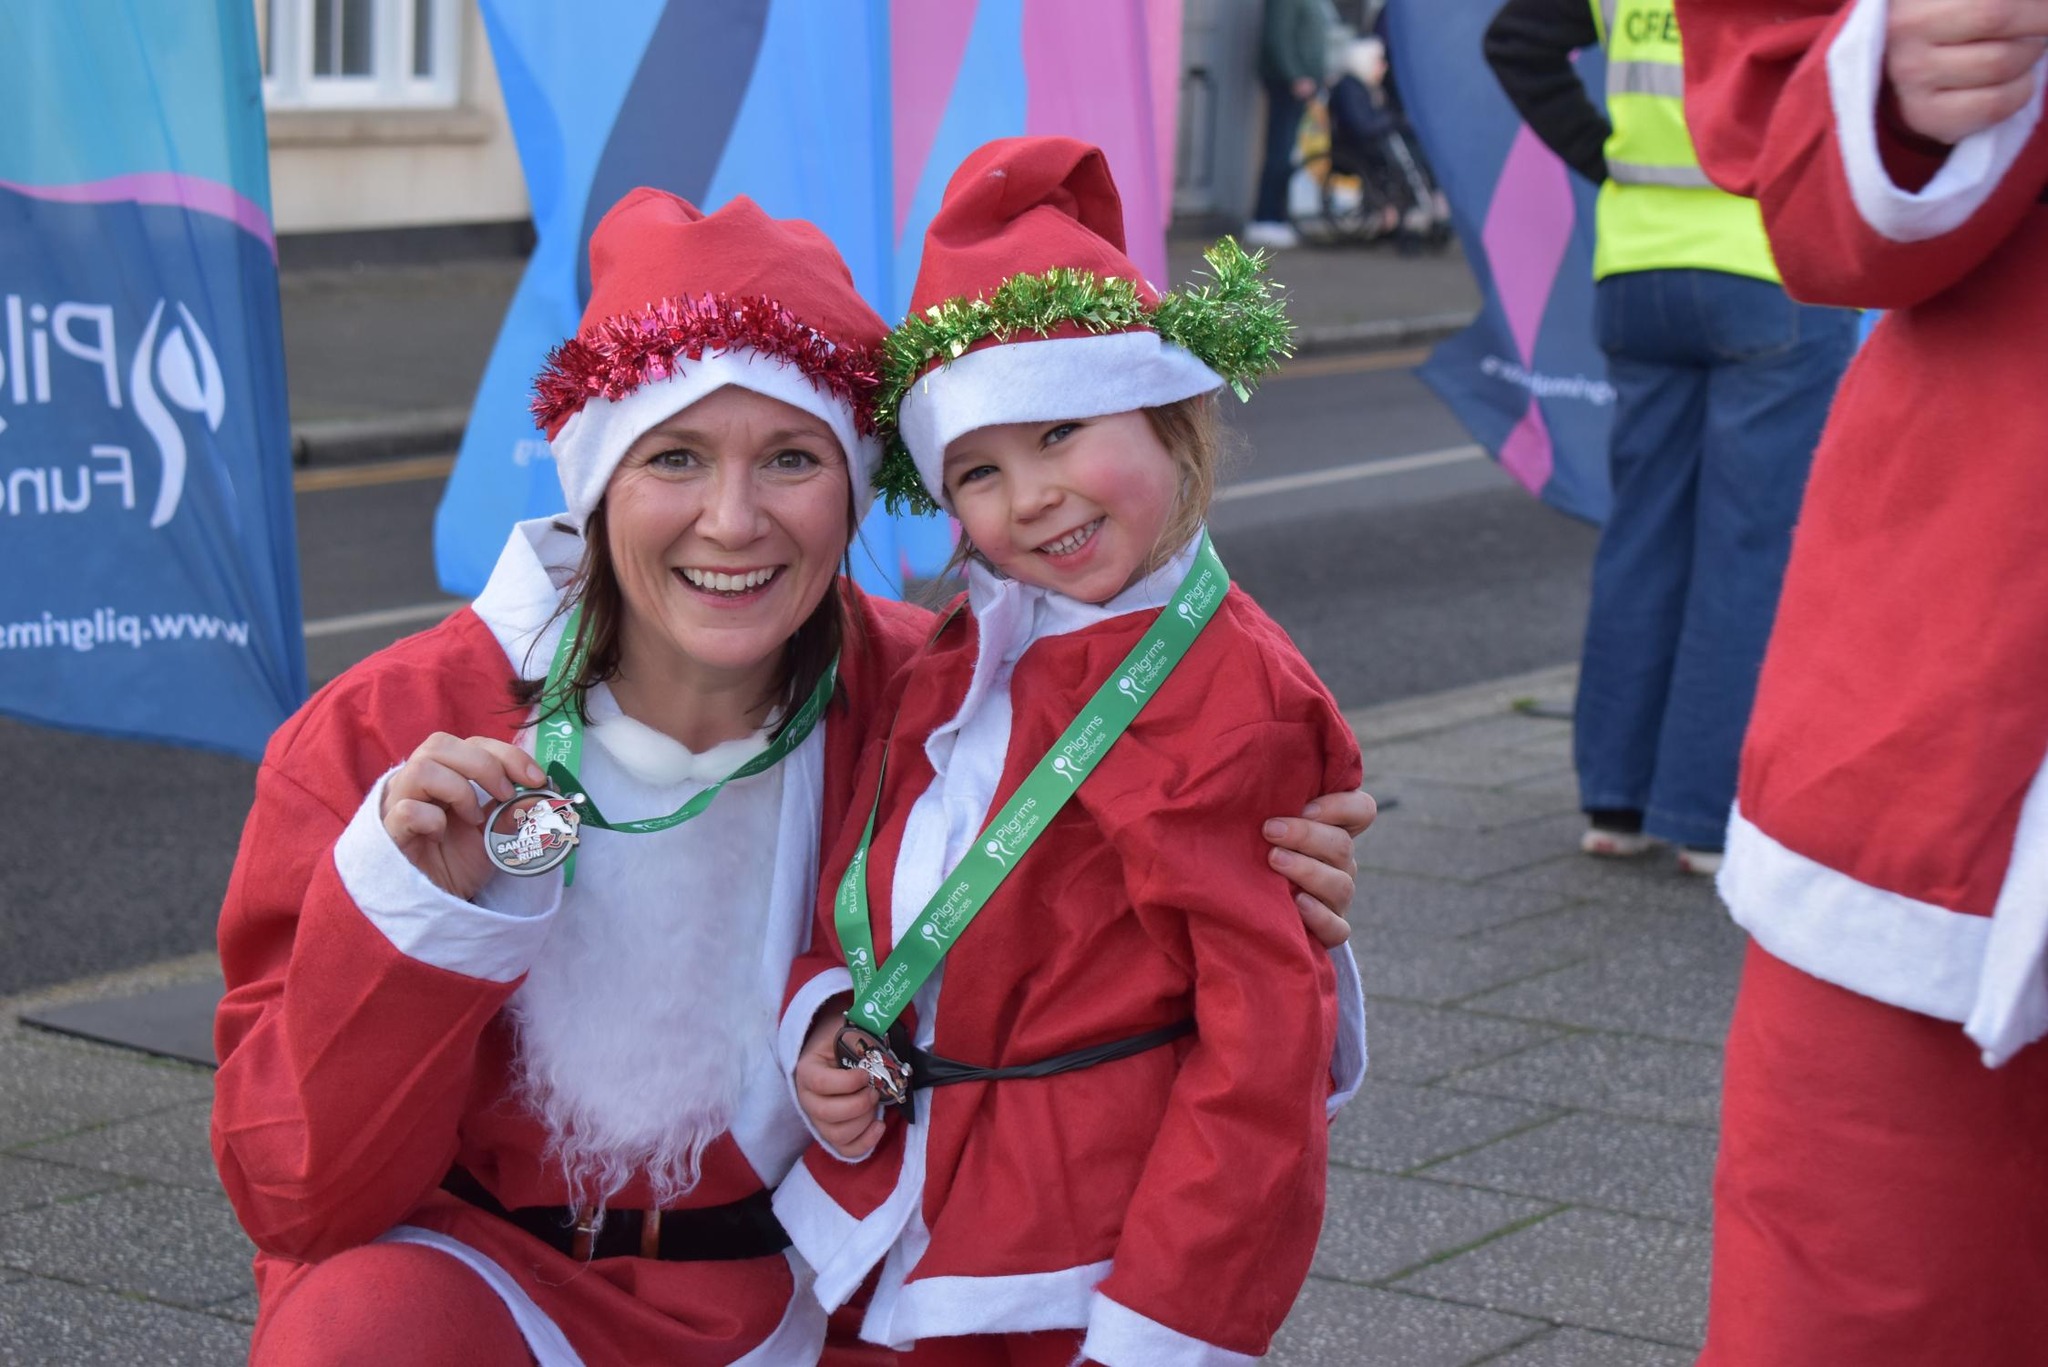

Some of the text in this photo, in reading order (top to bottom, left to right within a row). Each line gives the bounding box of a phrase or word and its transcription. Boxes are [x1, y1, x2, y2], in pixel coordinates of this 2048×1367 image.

[1184, 569, 1212, 603] Pilgrims
[1196, 584, 1218, 612] Hospices
[1128, 639, 1166, 679] Pilgrims
[1141, 655, 1168, 687] Hospices
[1063, 714, 1103, 757] Pilgrims
[1076, 731, 1106, 765] Hospices
[525, 824, 537, 835] 12
[996, 797, 1037, 841] Pilgrims
[1008, 814, 1040, 849] Hospices
[497, 836, 541, 854] SANTAS
[519, 848, 544, 861] RUN!
[930, 881, 970, 925] Pilgrims
[943, 898, 972, 932] Hospices
[872, 961, 909, 1004] Pilgrims
[883, 978, 911, 1011] Hospices
